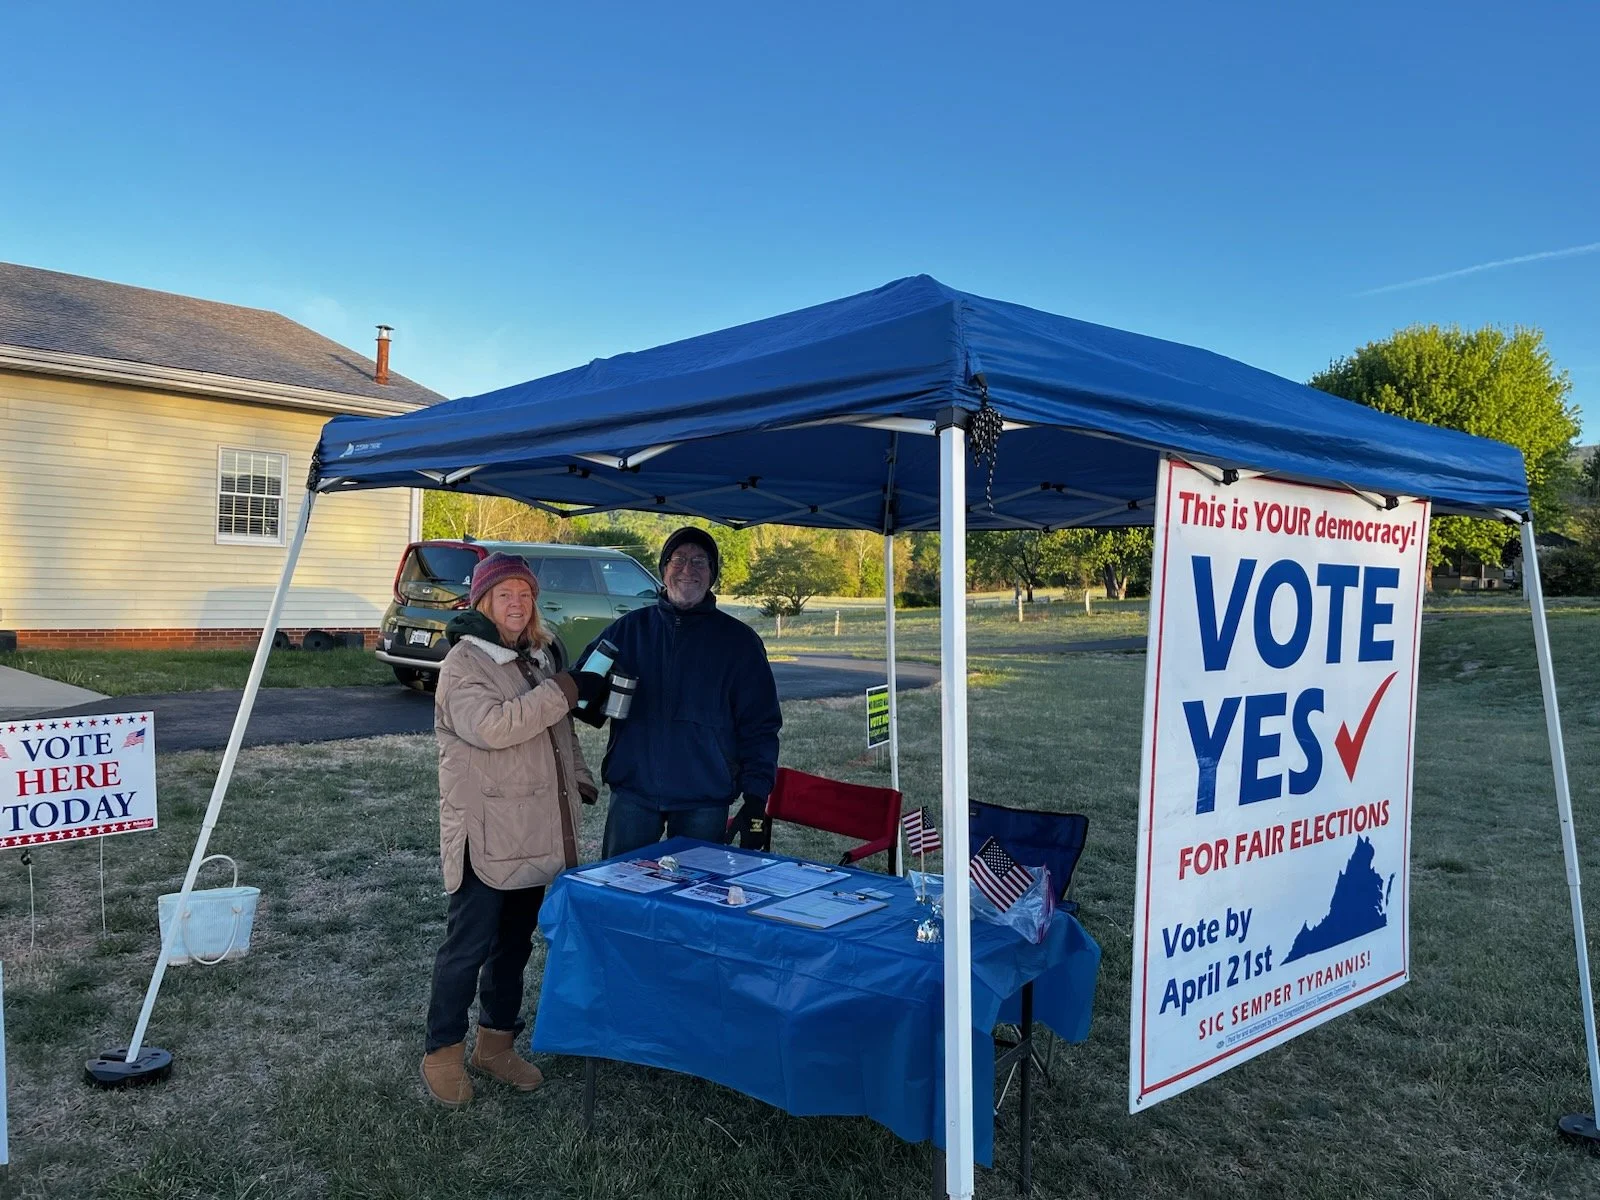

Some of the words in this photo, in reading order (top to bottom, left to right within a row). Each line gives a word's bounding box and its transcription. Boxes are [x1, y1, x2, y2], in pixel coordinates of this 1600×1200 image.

[1179, 491, 1225, 528] This
[1231, 498, 1247, 531] is
[1253, 501, 1310, 537] YOUR
[1315, 509, 1417, 553] democracy!
[1191, 555, 1400, 672] VOTE
[16, 761, 122, 797] HERE
[20, 732, 113, 762] VOTE
[1182, 687, 1325, 815] YES
[2, 791, 137, 832] TODAY
[1178, 838, 1229, 880] FOR
[1234, 824, 1285, 865] FAIR
[1290, 799, 1390, 849] ELECTIONS
[1162, 918, 1220, 959] Vote
[1225, 907, 1253, 944] by
[1159, 963, 1221, 1017] April
[1226, 944, 1273, 989] 21st
[1198, 1010, 1225, 1040] SIC
[1231, 985, 1292, 1026] SEMPER
[1297, 950, 1372, 996] TYRANNIS!
